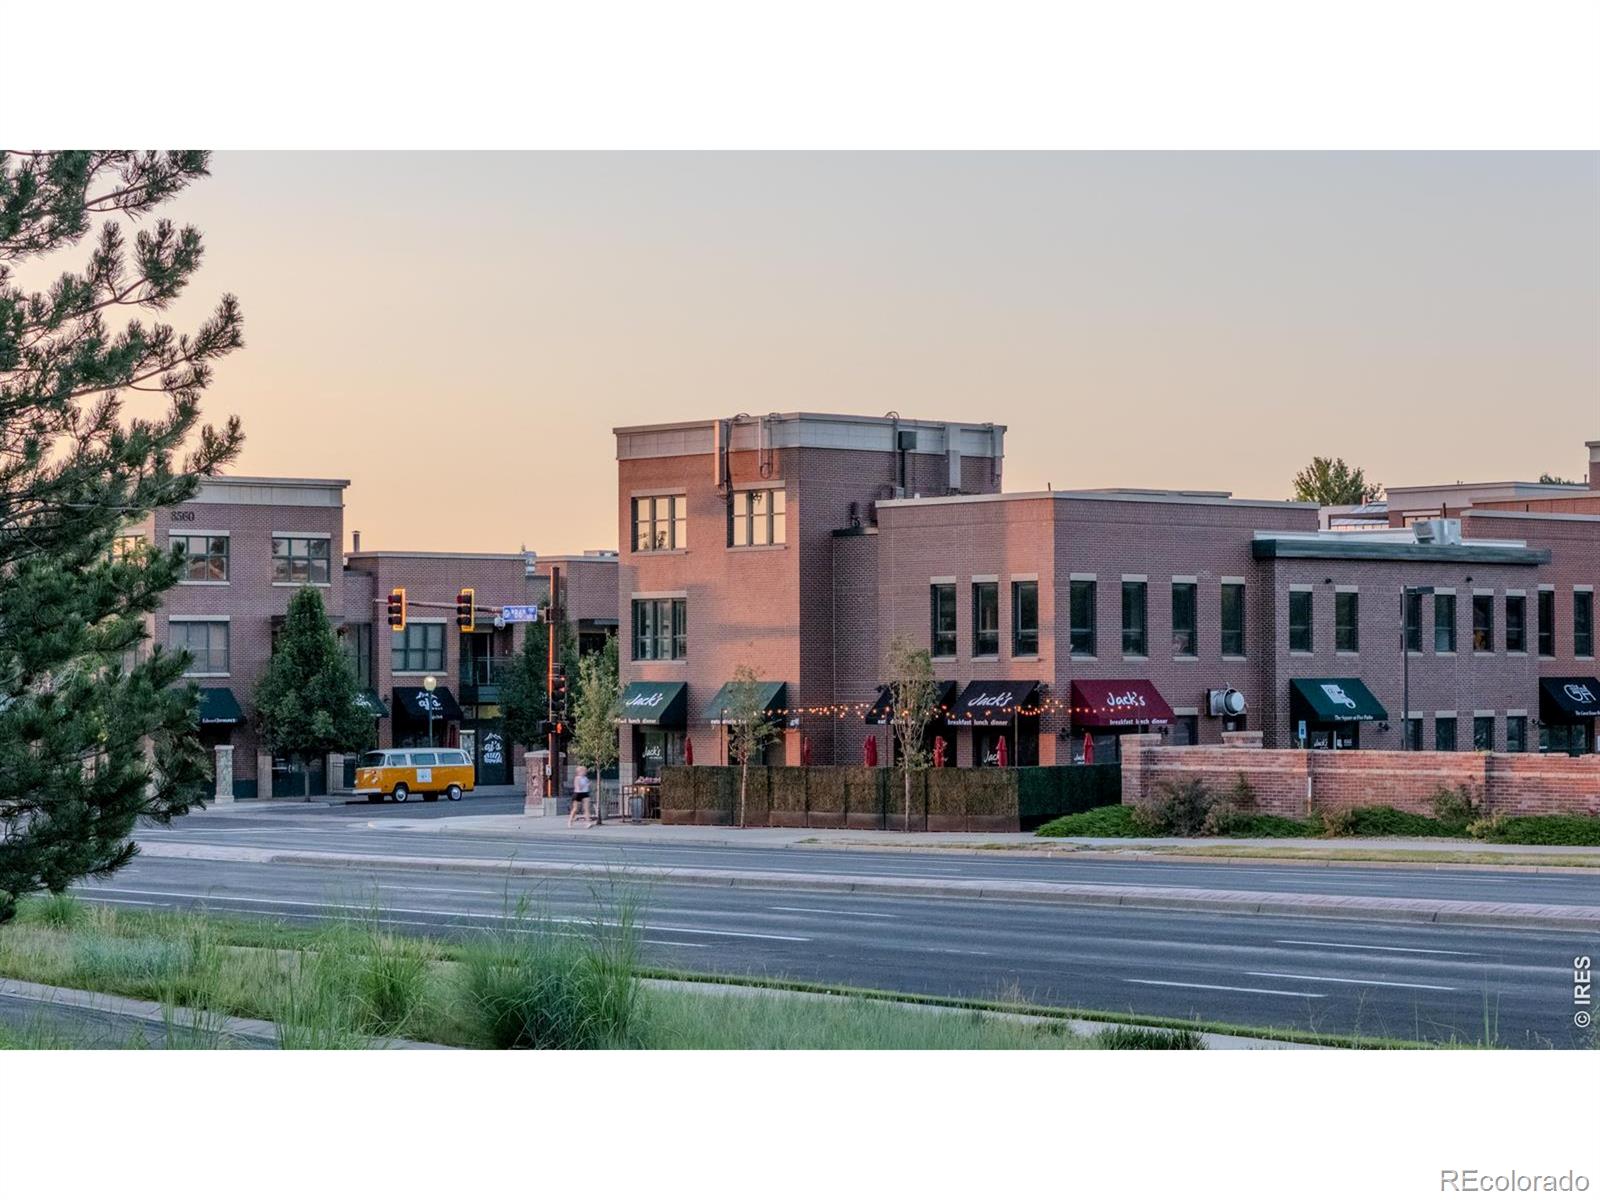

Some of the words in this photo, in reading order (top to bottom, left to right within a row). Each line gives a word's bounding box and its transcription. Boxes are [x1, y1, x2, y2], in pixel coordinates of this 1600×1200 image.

[626, 693, 664, 707] Jack's
[967, 692, 1013, 707] Jack's
[1106, 691, 1146, 706] Jack's
